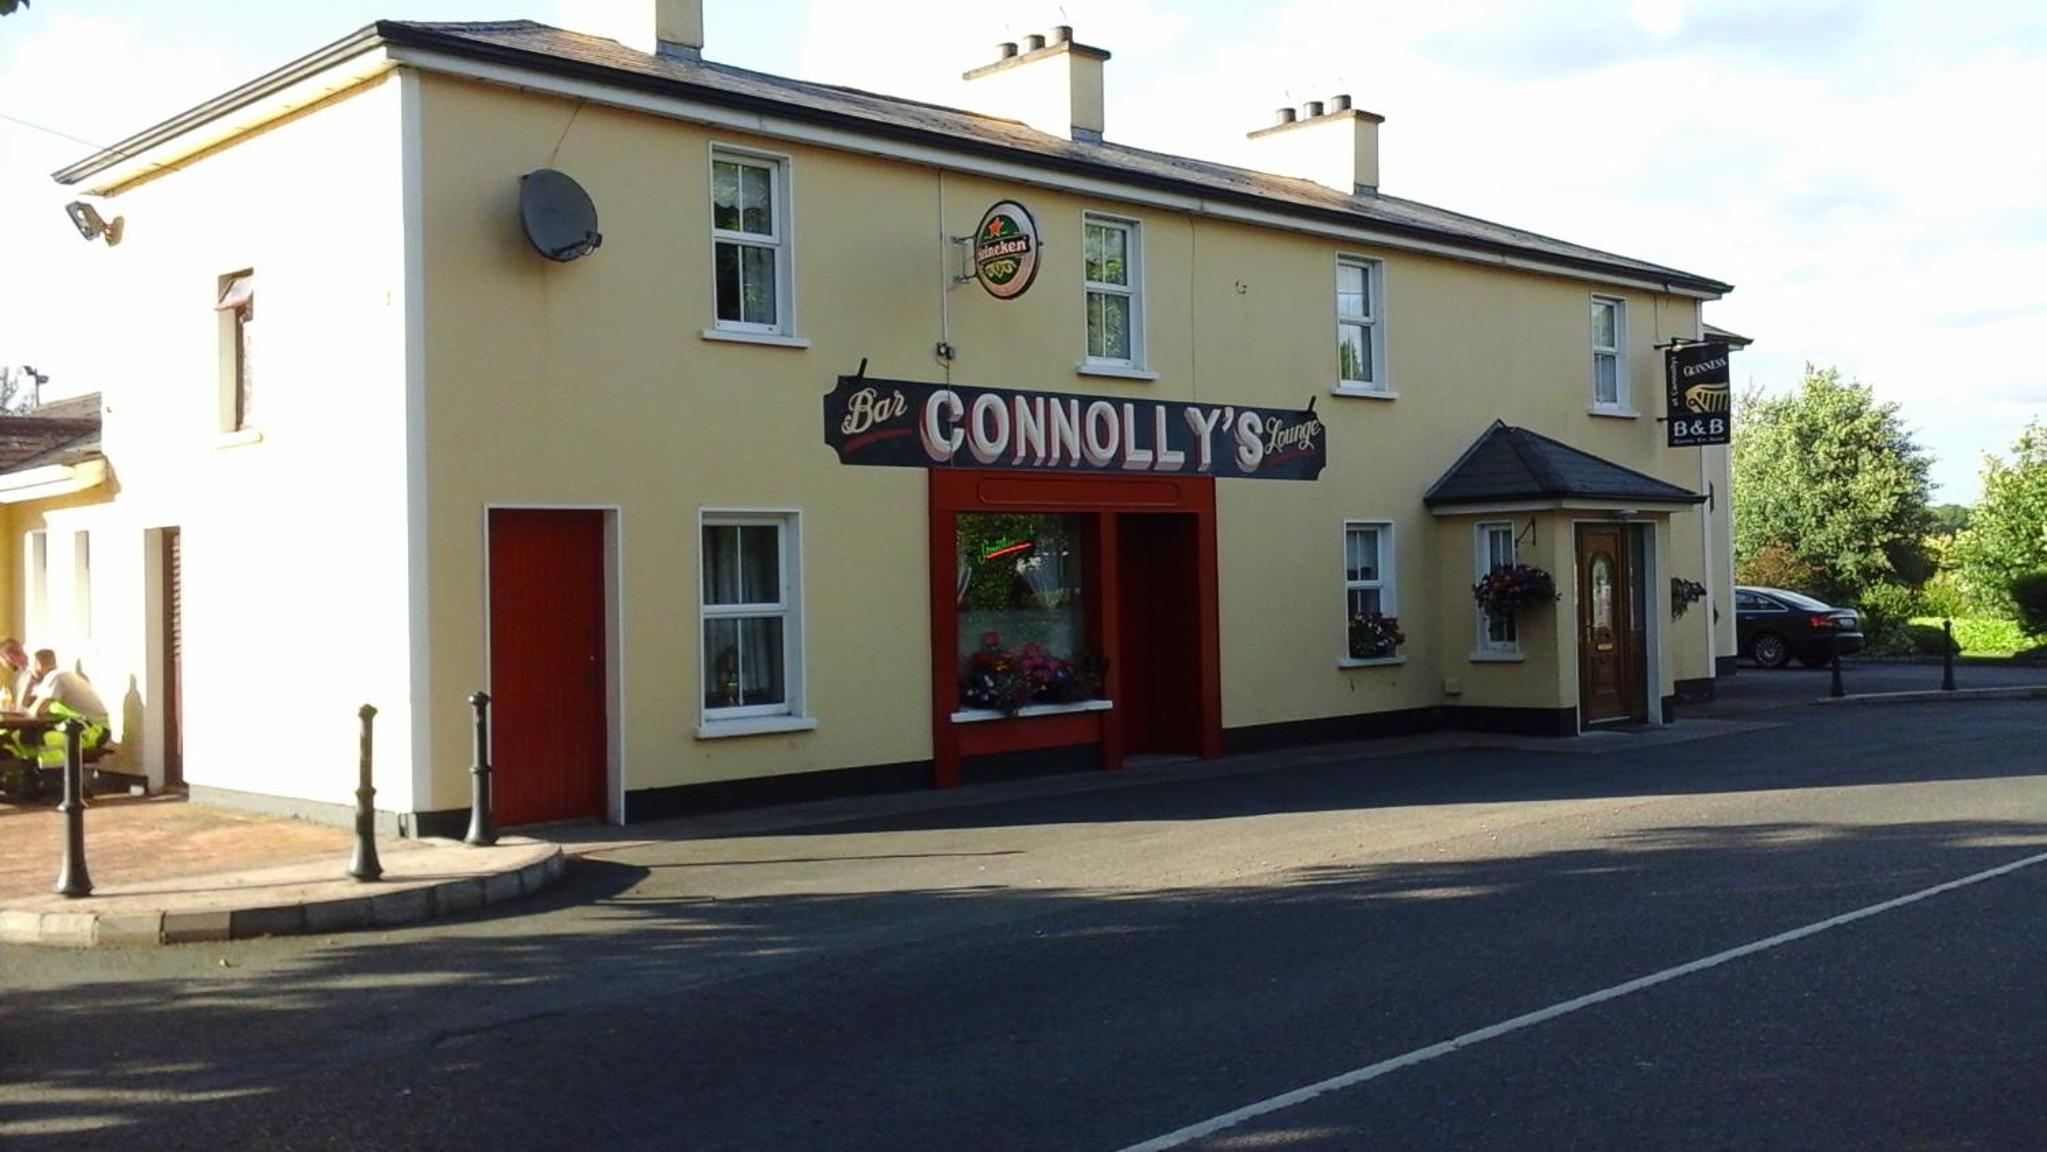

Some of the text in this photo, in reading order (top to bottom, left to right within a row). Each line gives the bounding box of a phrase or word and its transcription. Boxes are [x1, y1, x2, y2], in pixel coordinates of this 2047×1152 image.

[841, 387, 1321, 473] Bar CONNOLLY'S Lounge
